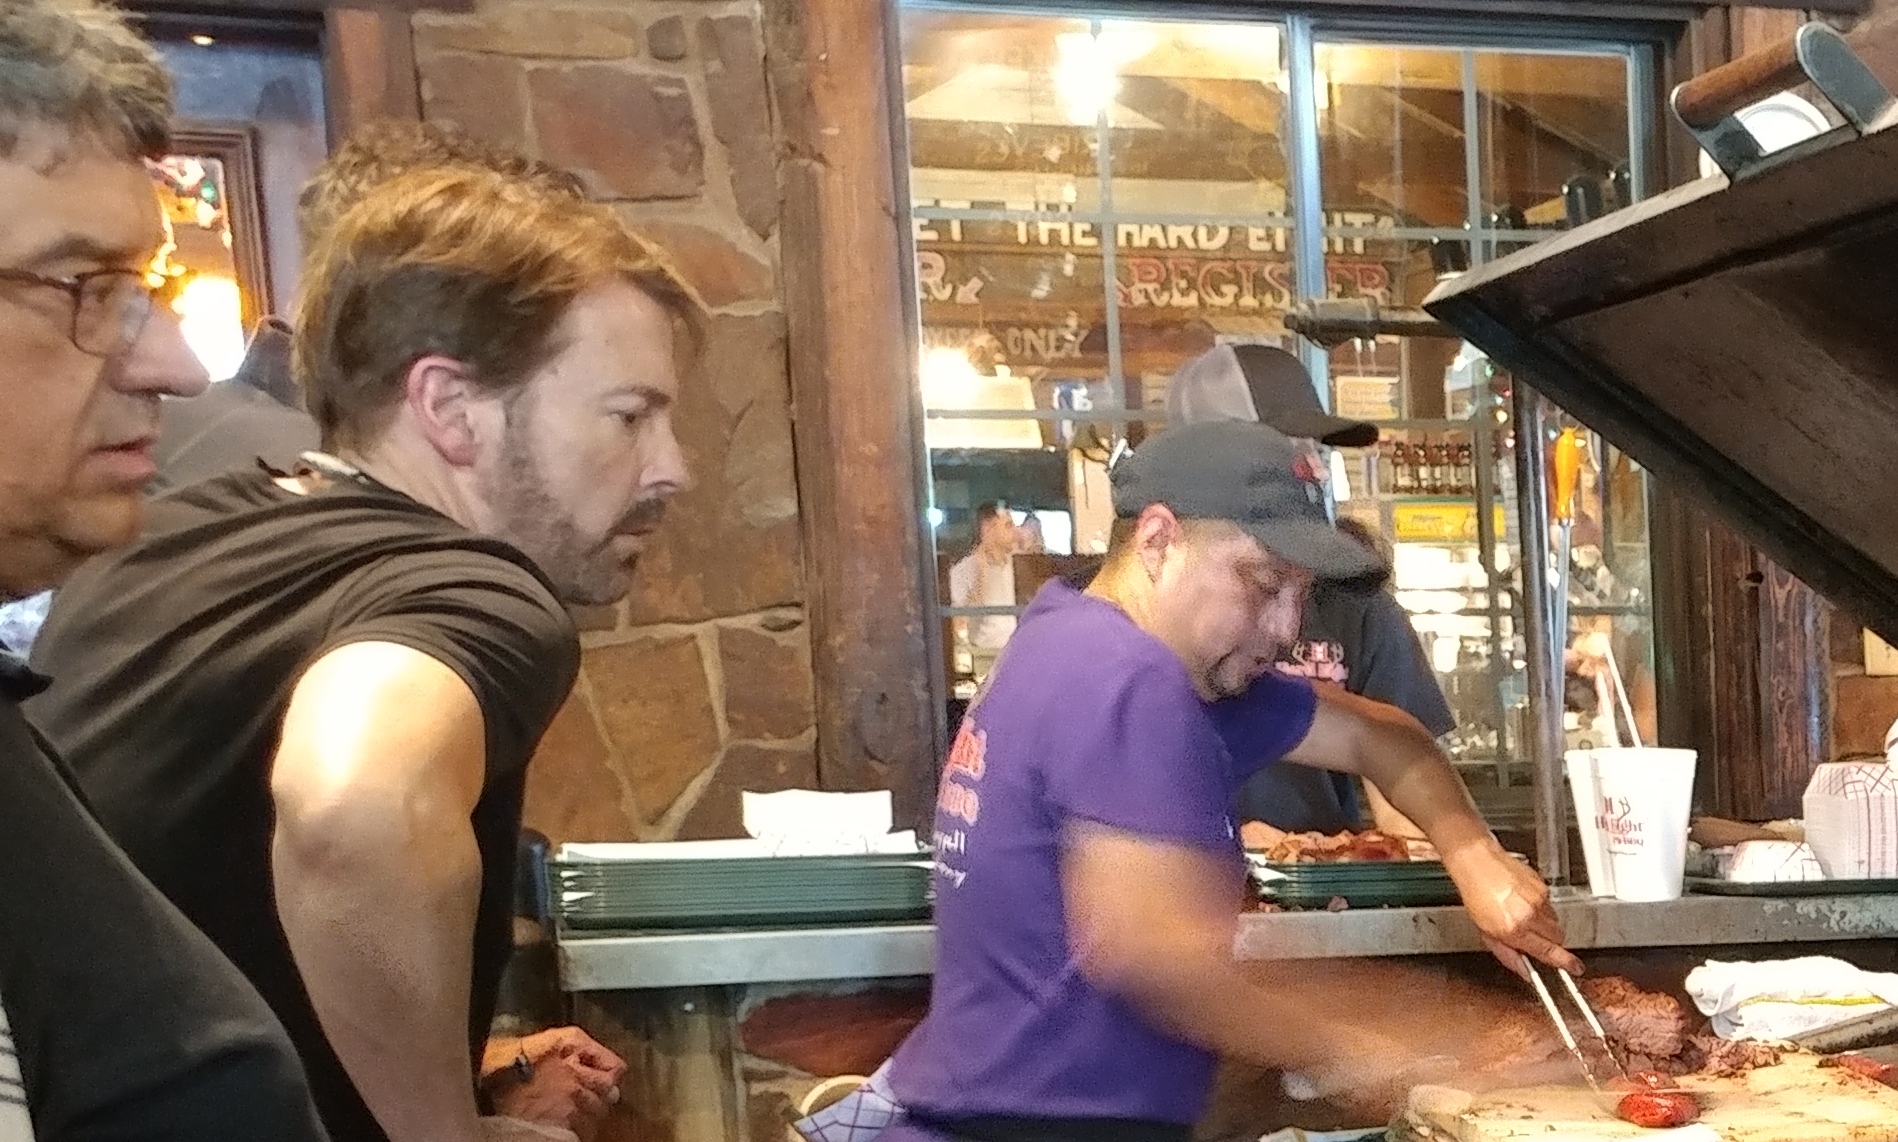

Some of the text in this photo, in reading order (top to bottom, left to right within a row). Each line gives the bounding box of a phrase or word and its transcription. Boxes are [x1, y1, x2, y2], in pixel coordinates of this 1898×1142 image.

[1004, 198, 1099, 246] THE
[1116, 212, 1230, 251] HARD
[1116, 256, 1391, 309] REGISER
